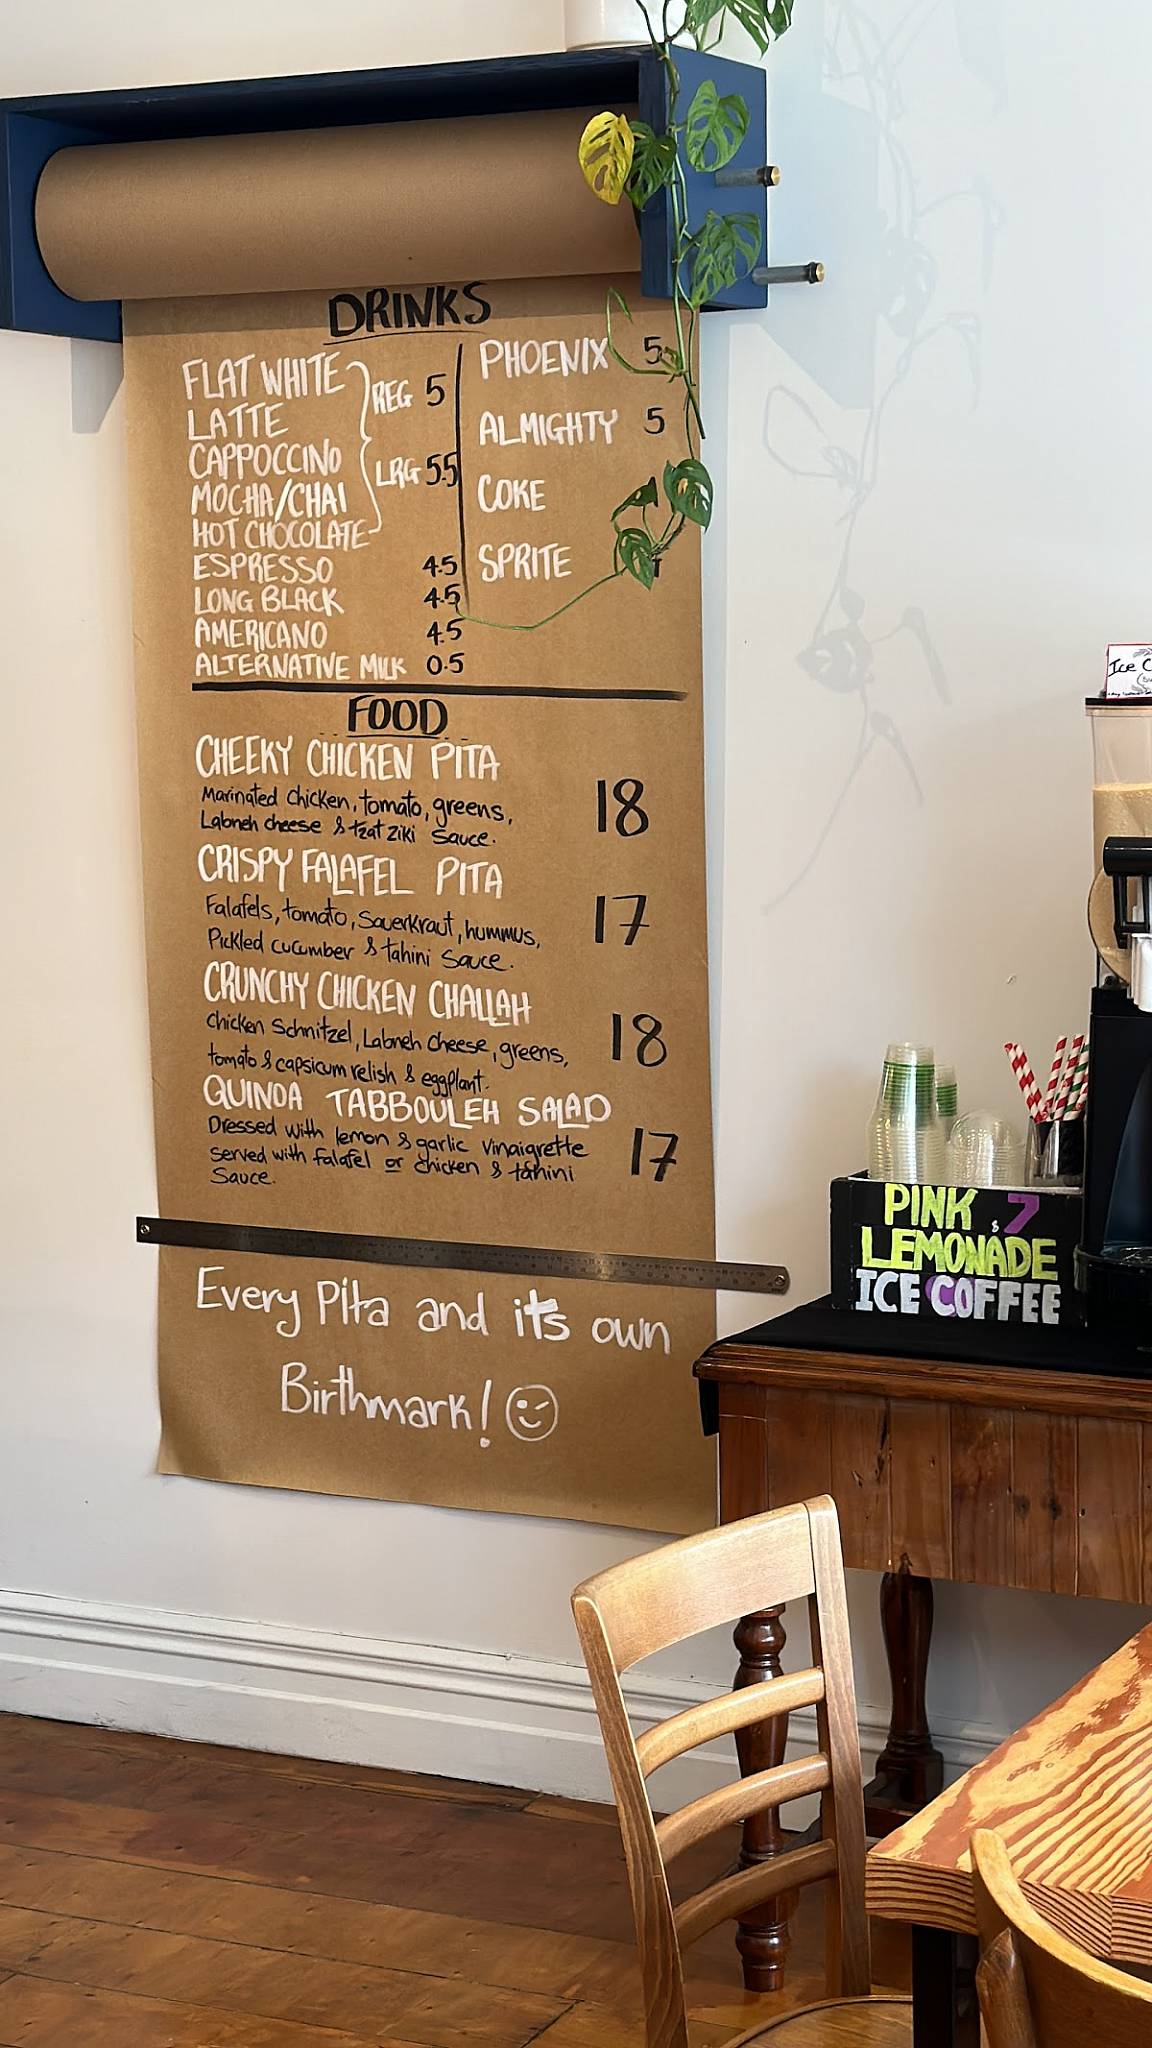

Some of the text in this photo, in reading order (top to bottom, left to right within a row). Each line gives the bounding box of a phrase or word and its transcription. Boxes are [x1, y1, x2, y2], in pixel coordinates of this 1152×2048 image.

[327, 280, 491, 338] DRINKS
[479, 337, 609, 380] PHOENIX
[643, 336, 663, 365] 5
[182, 351, 345, 400] FLAT WHITE
[426, 373, 447, 407] 5
[371, 379, 413, 415] REG
[187, 402, 289, 441] LATTE
[479, 409, 619, 446] ALMIGHTY
[643, 407, 666, 435] 5
[188, 438, 342, 481] CAPPOCCINO
[375, 457, 422, 489] LRG
[191, 478, 347, 523] MOCHA/CHAI
[477, 474, 546, 513] COKE
[192, 517, 370, 552] HOT CHOCOLATE
[193, 552, 334, 585] ESPRESSO
[422, 555, 458, 578] 4.5
[477, 542, 572, 583] SPRITE
[194, 585, 345, 617] LONG BLACK
[423, 583, 461, 609] 4.5
[194, 617, 328, 652] AMERICANO
[426, 618, 465, 646] 4.5
[195, 651, 408, 681] ALTERNATIVE MILK
[426, 652, 465, 676] 0.5
[1107, 658, 1137, 678] Ice
[347, 694, 449, 736] FOOD
[195, 734, 501, 781] CHEEKY CHICKEN PITA
[200, 810, 259, 832] Labneh
[333, 816, 346, 836] &
[359, 788, 429, 823] tomato,
[433, 797, 513, 828] greens,
[596, 777, 650, 837] 18
[198, 843, 503, 899] CRISPY FALAFEL PITA
[206, 893, 281, 926] Falafels,
[282, 897, 356, 931] tomato,
[465, 919, 541, 949] hummus,
[594, 894, 650, 946] 17
[208, 927, 264, 951] Pickled
[271, 936, 354, 960] cucumber
[366, 936, 378, 956] &
[381, 938, 431, 967] tahini
[204, 960, 532, 1027] CRUNCHY CHICKEN CHALLAH
[363, 1028, 422, 1051] Labneh
[499, 1040, 569, 1069] greens,
[611, 1013, 667, 1068] 18
[208, 1044, 490, 1098] tomato & capsicum relish & eggplant.
[203, 1074, 612, 1129] QUINOA TABBOULEH SALAD
[208, 1114, 277, 1135] Dressed
[285, 1117, 324, 1140] with
[336, 1126, 390, 1147] lemon
[399, 1132, 412, 1150] &
[416, 1137, 470, 1160] garlic
[631, 1127, 679, 1183] 17
[272, 1142, 307, 1165] with
[312, 1146, 371, 1170] falafel
[385, 1155, 403, 1173] or
[490, 1161, 502, 1179] &
[507, 1160, 575, 1183] tahini
[884, 1182, 979, 1231] PINK
[861, 1225, 1059, 1281] LEMONADE
[197, 1264, 672, 1355] Every Pita and its own
[855, 1268, 1062, 1325] ICE COFFEE
[280, 1361, 493, 1449] Birthmark!
